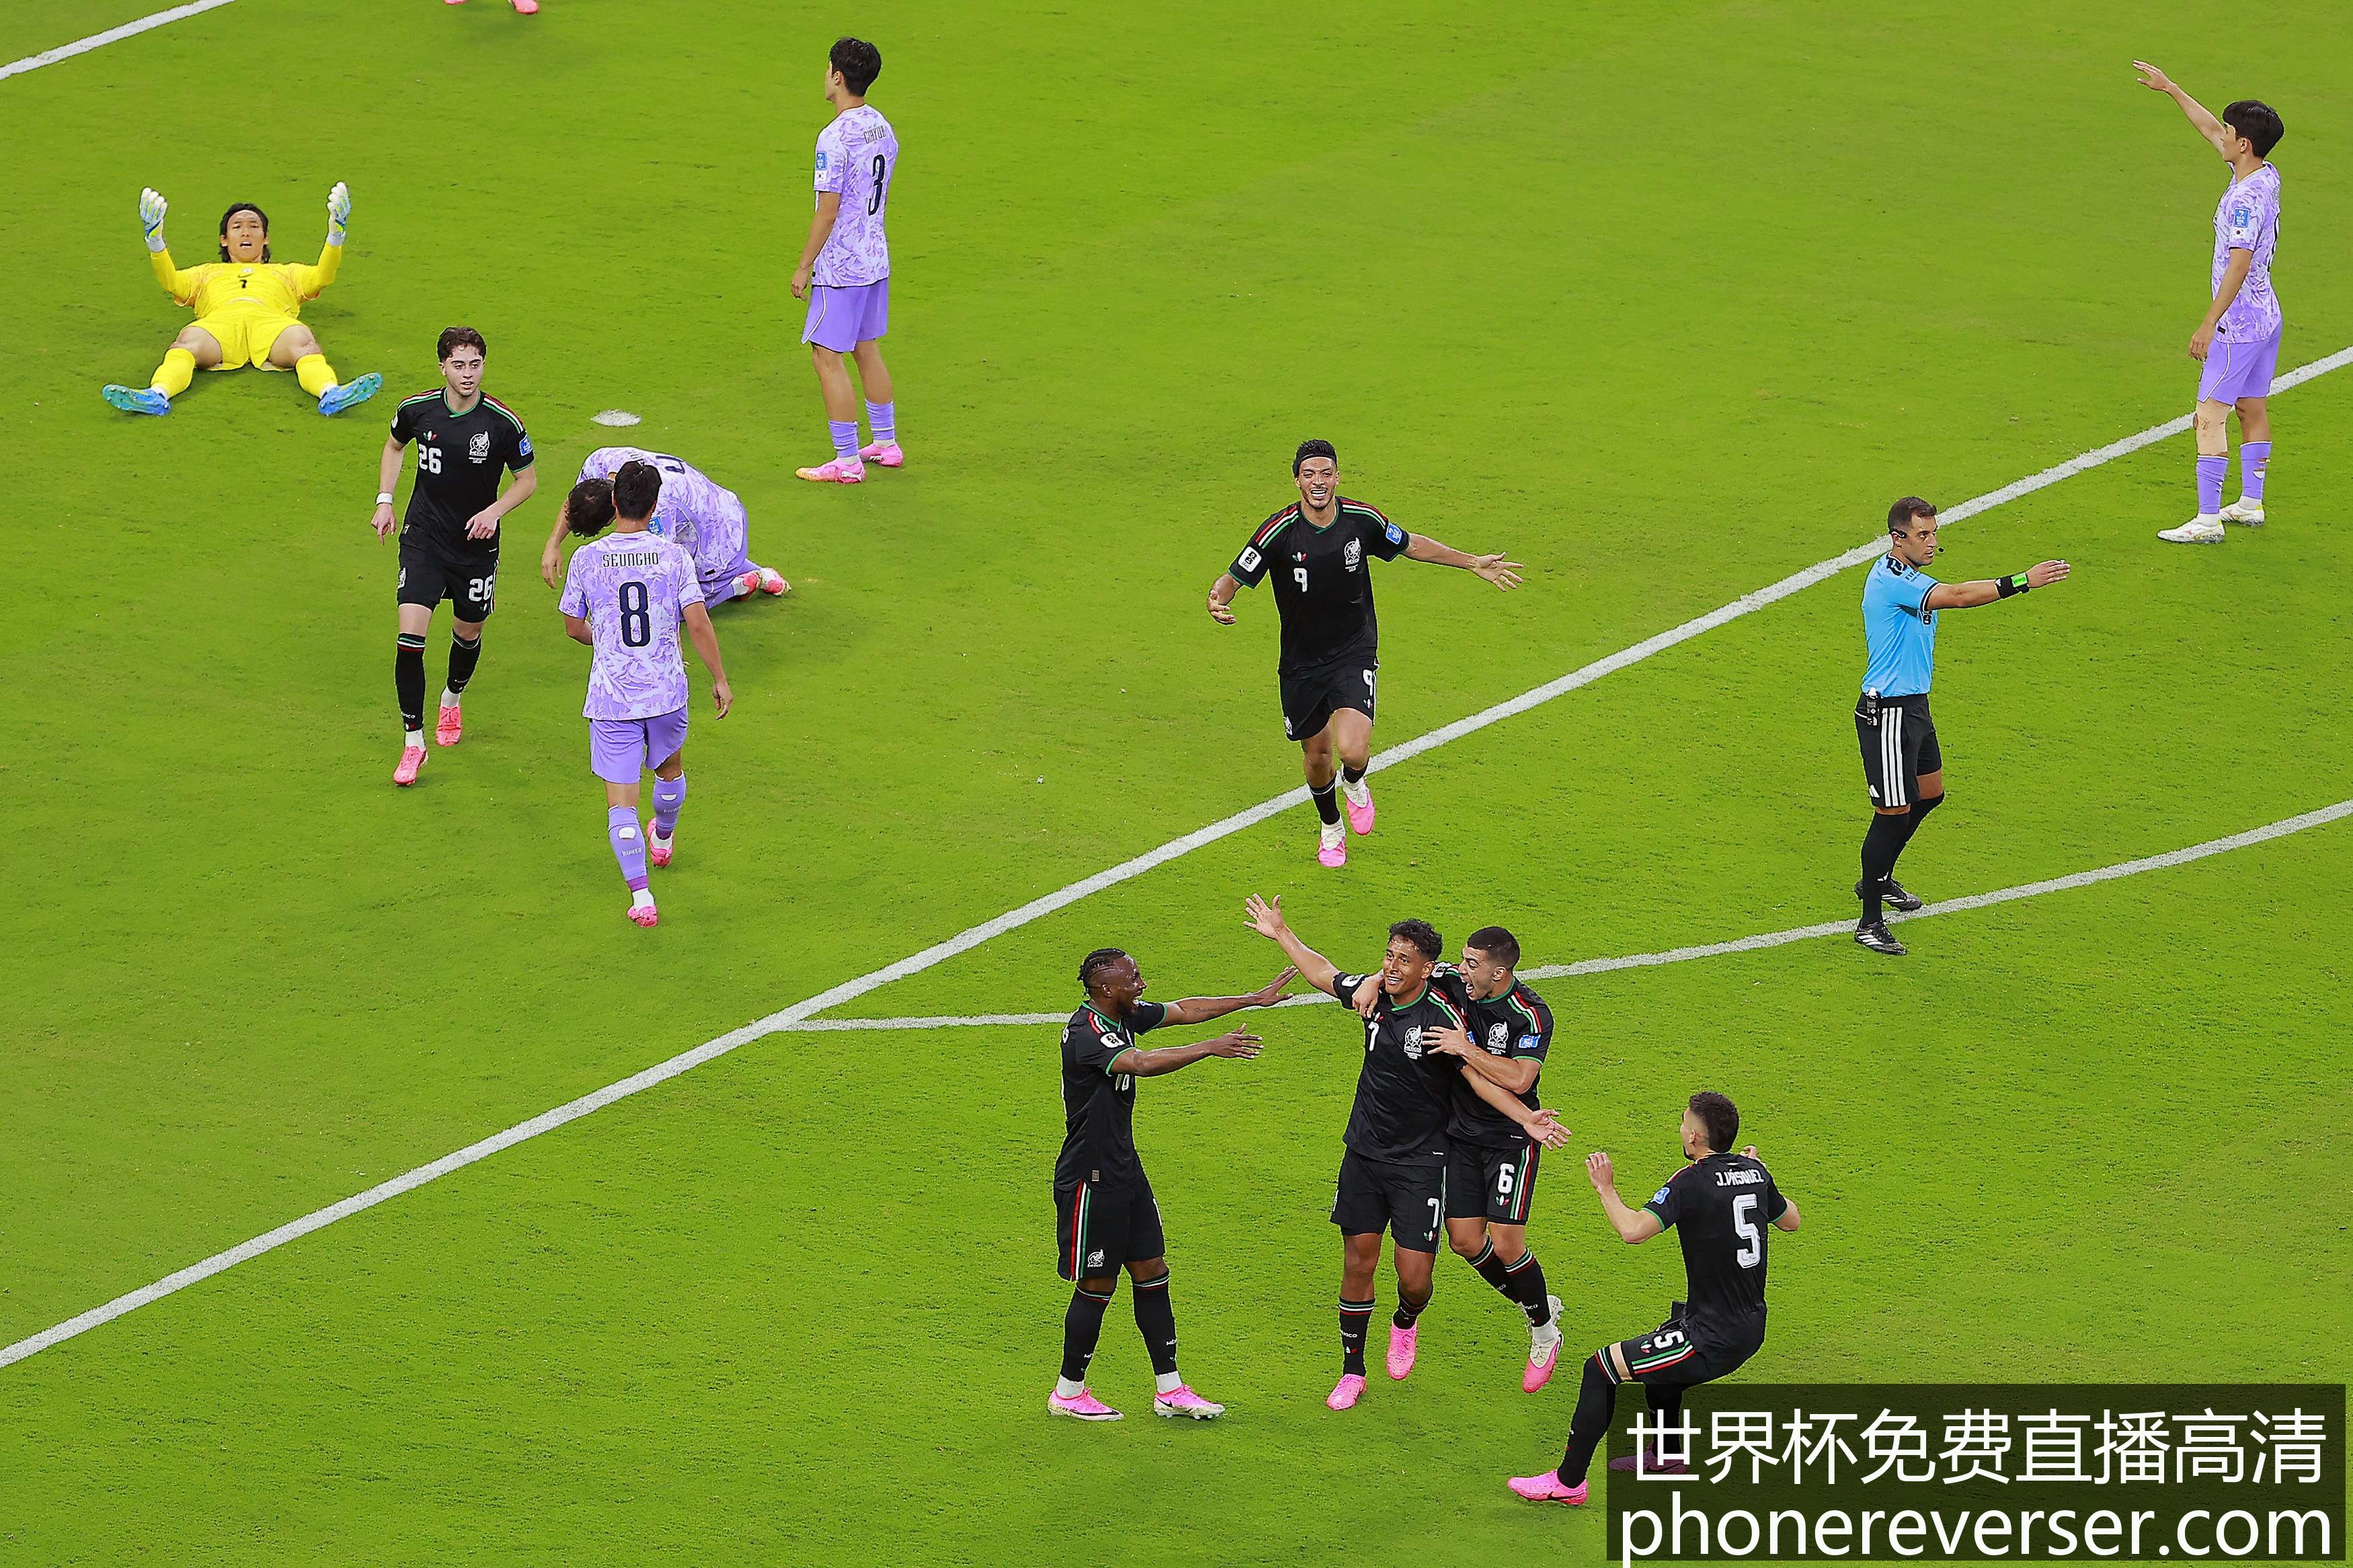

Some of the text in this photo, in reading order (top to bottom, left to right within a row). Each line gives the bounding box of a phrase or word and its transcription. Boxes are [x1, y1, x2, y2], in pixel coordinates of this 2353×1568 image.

[868, 154, 885, 216] 3
[418, 444, 442, 474] 26
[602, 552, 660, 569] SEUNGHO
[469, 575, 493, 602] 26
[1293, 567, 1308, 593] 9
[619, 581, 651, 647] 8
[1363, 669, 1374, 696] 9
[1367, 1021, 1380, 1052] 7
[1497, 1163, 1515, 1194] 6
[1427, 1198, 1439, 1229] 7
[1732, 1194, 1761, 1269] 5
[1654, 1329, 1685, 1349] 5
